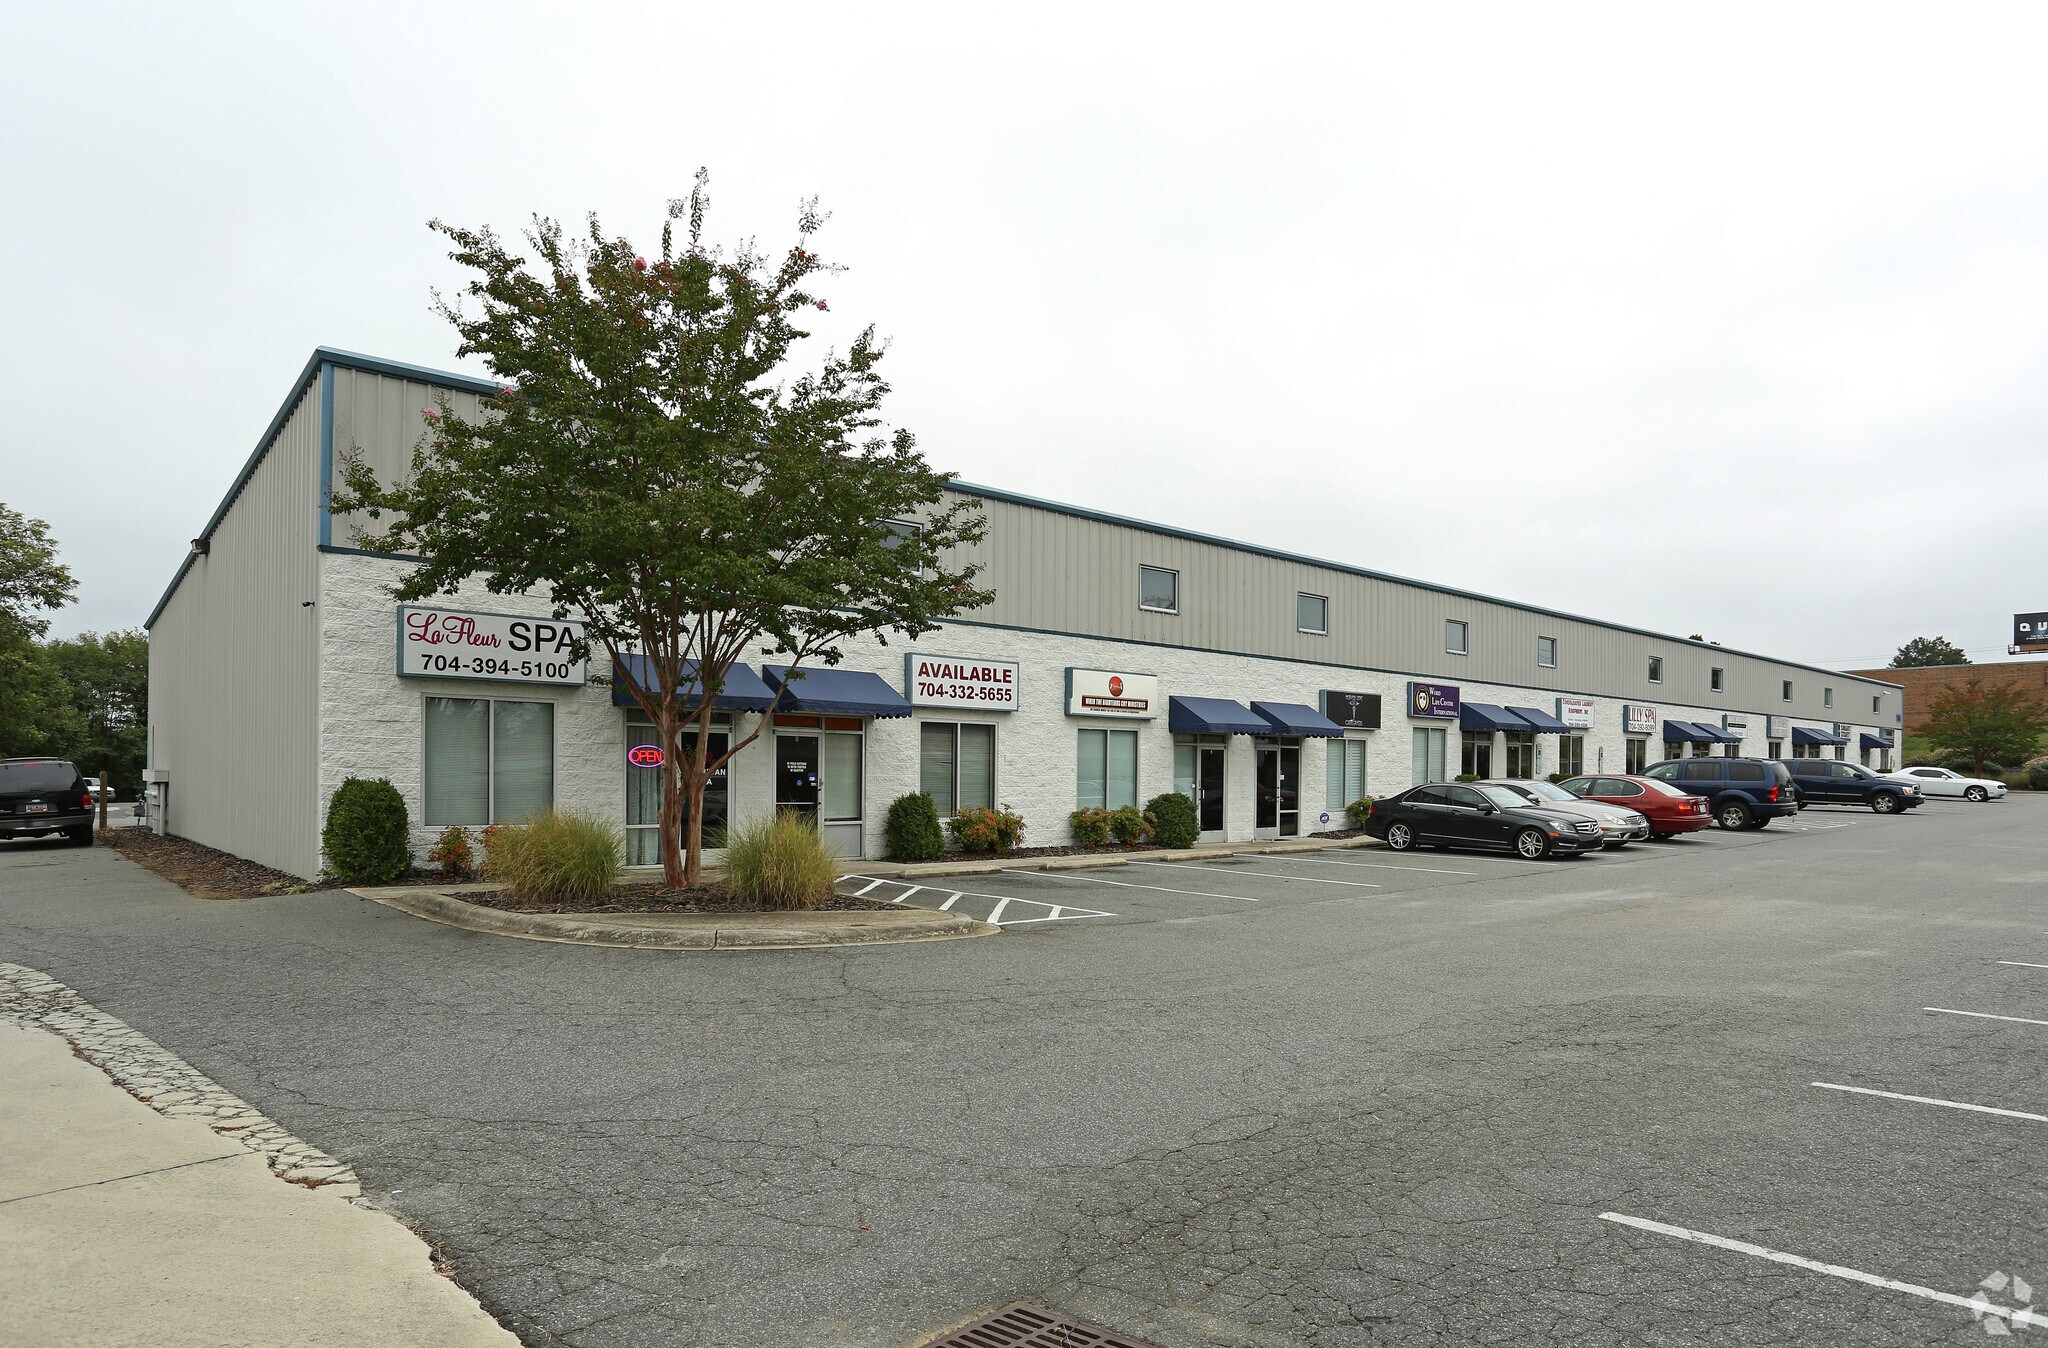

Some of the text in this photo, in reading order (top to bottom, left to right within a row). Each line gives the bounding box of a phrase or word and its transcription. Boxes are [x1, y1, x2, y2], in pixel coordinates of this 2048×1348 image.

[406, 612, 577, 654] La Fleur SPA
[421, 654, 569, 679] 704-394-5100
[918, 662, 1012, 683] AVAILABLE
[918, 682, 1012, 702] 704-332-5655
[1629, 707, 1655, 723] LILLY SPA
[630, 750, 663, 763] OPEN
